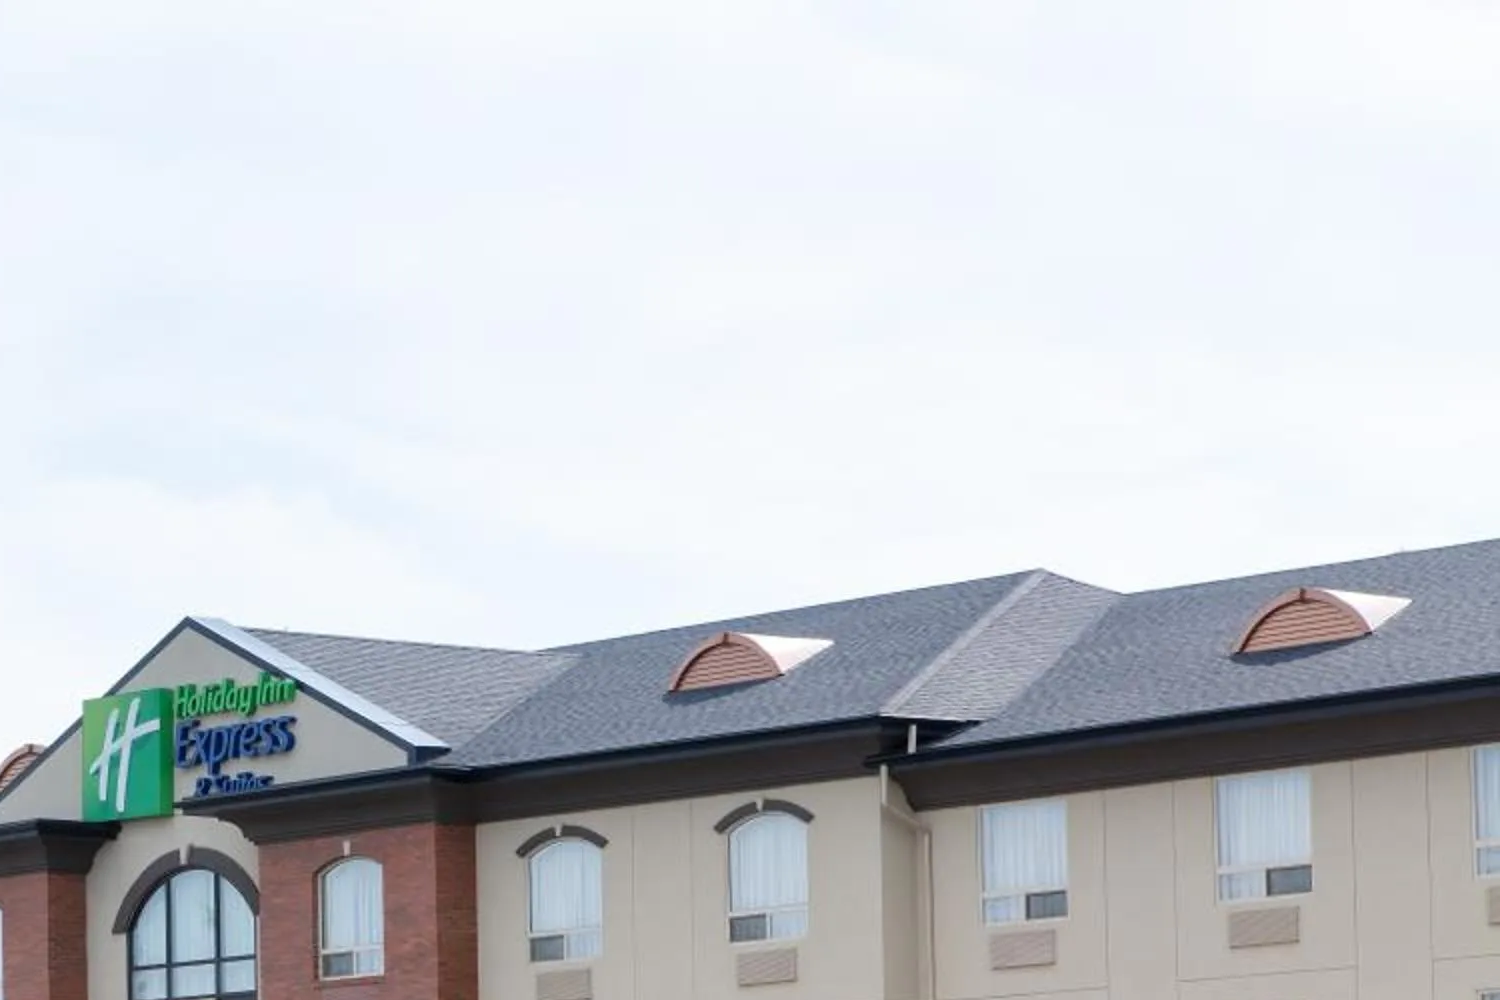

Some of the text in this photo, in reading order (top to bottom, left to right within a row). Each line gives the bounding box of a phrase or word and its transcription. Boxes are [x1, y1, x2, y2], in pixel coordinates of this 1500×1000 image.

[174, 671, 296, 719] Holiday Inn
[175, 715, 297, 775] Express
